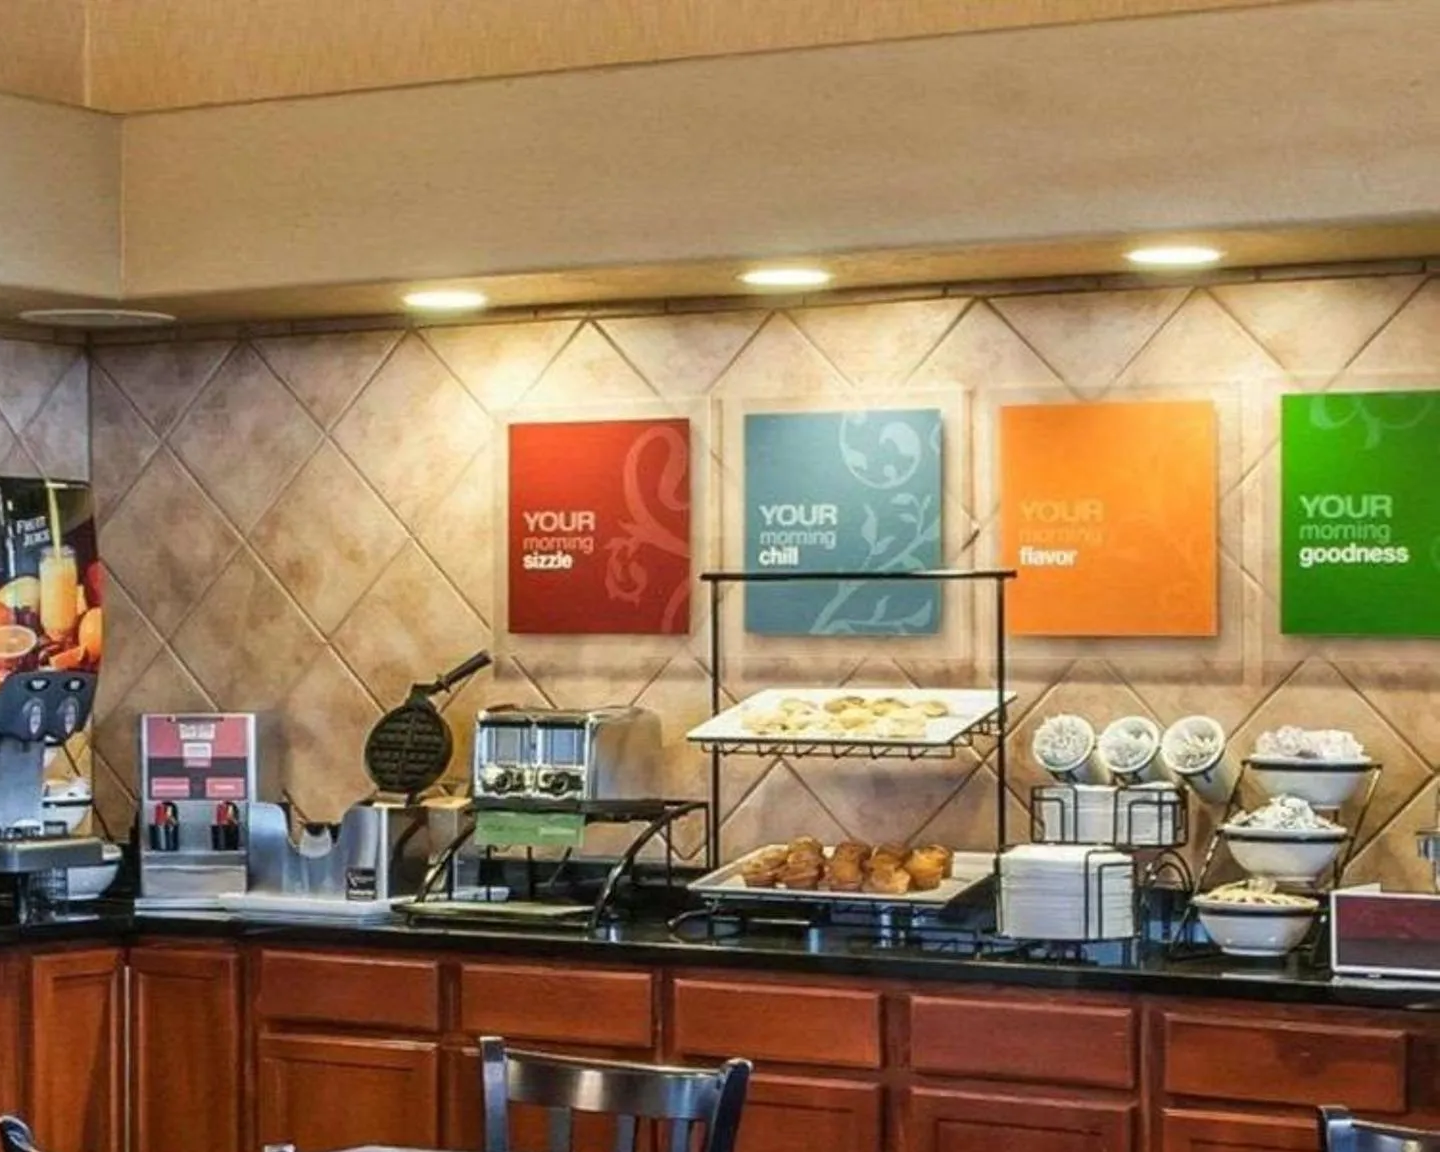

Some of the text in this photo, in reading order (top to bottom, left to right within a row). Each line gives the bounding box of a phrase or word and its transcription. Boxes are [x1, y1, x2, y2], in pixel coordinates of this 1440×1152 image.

[758, 503, 838, 526] YOUR
[1017, 500, 1104, 523] YOUR
[1299, 494, 1393, 519] YOUR
[522, 511, 596, 532] YOUR
[759, 531, 837, 550] morning
[1299, 524, 1392, 545] morning
[523, 536, 595, 555] morning
[758, 546, 799, 566] chill
[1299, 542, 1410, 568] goodness
[522, 551, 574, 570] sizzle
[1019, 546, 1078, 567] flavor
